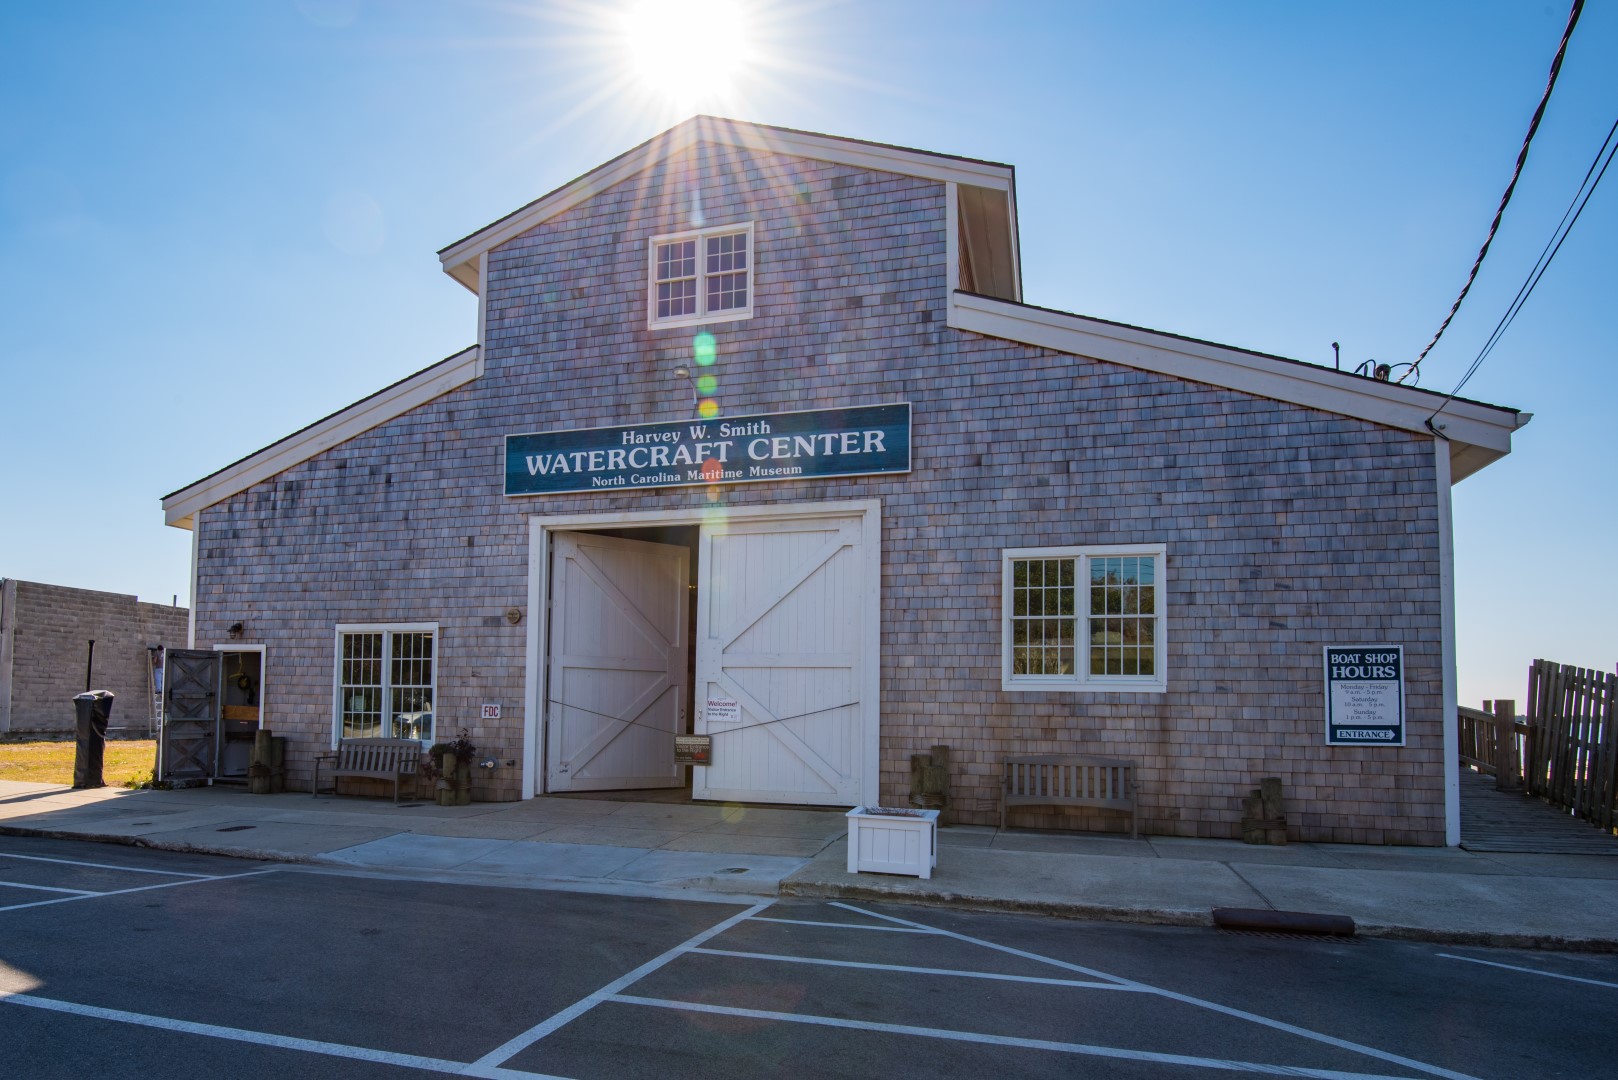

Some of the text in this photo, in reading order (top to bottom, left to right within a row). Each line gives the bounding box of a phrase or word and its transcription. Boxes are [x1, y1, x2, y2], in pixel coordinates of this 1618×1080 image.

[621, 420, 771, 445] Harvey W. Smith
[525, 430, 886, 476] WATERCRAFT CENTER
[592, 466, 802, 487] North Carolina Maritime Museum
[1331, 653, 1397, 664] BOAT SHOP
[1332, 665, 1396, 678] HOURS
[484, 706, 499, 717] FDC
[1339, 730, 1390, 739] ENTRANCE
